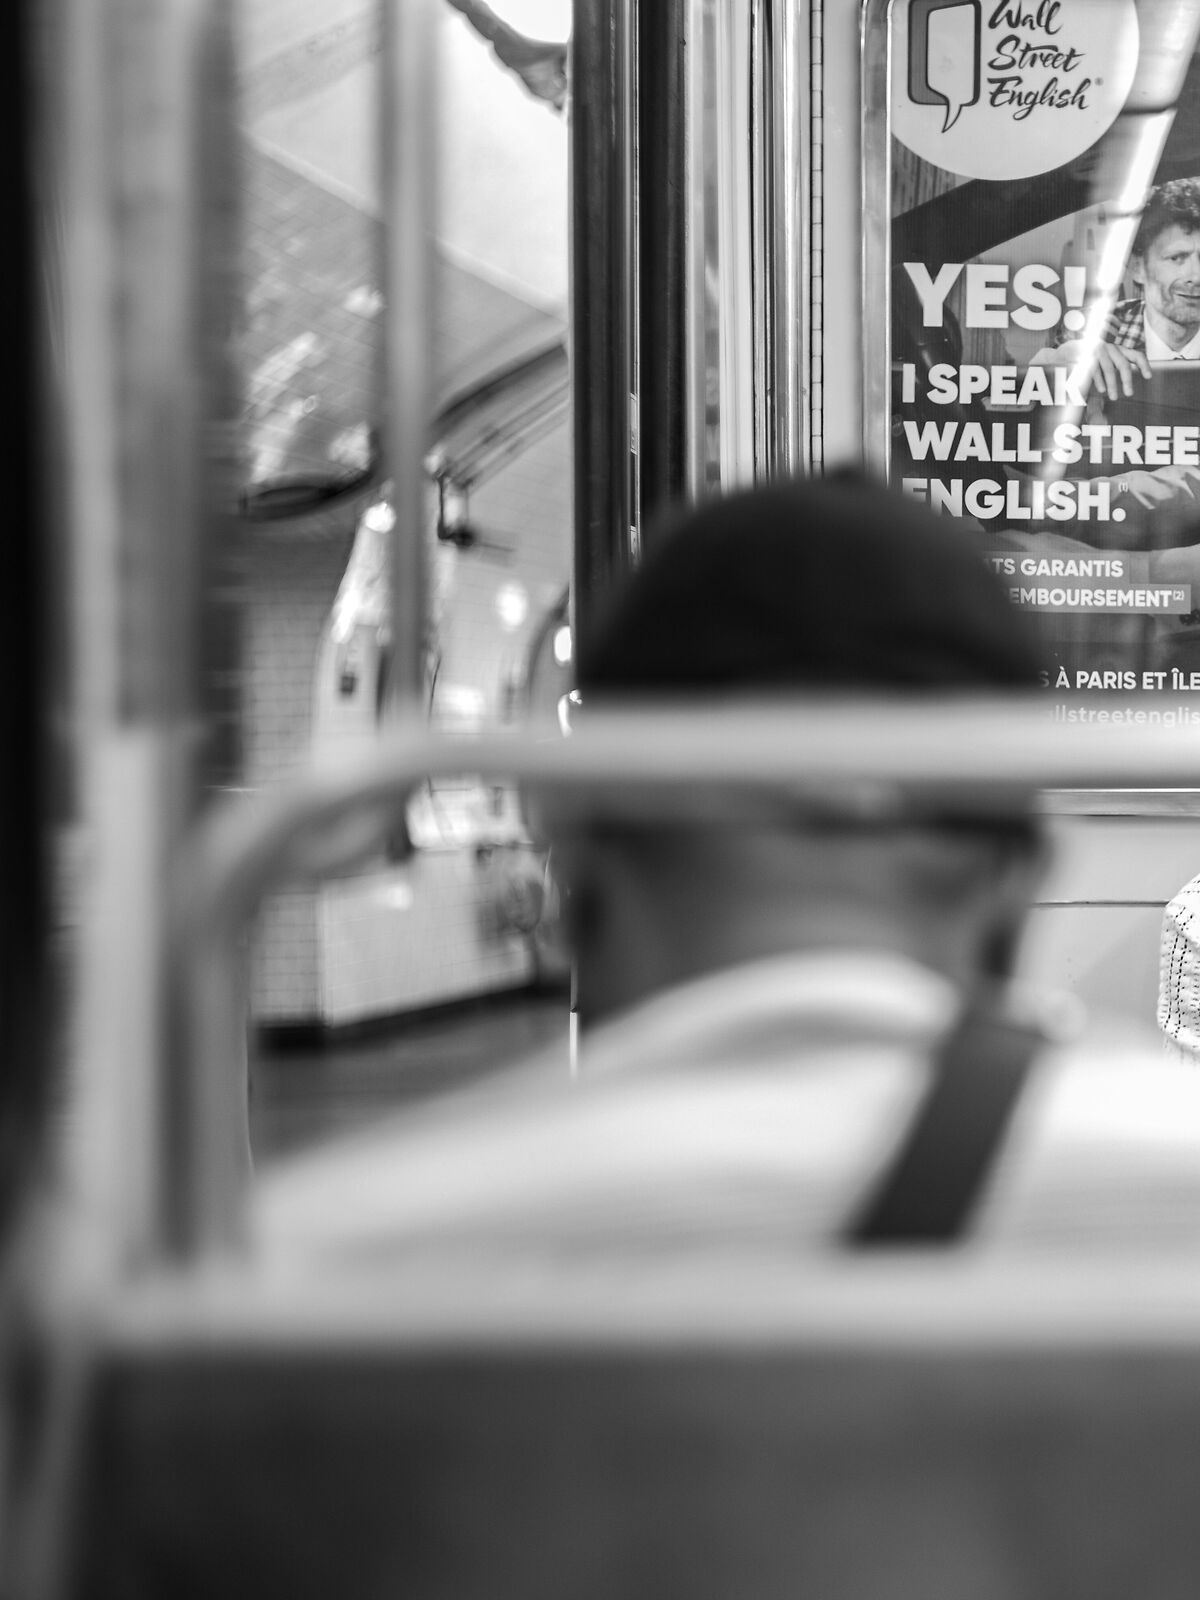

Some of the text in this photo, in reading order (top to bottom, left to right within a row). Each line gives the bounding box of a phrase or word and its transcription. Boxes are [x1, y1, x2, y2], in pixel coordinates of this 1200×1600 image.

[988, 0, 1064, 35] Wall
[987, 34, 1086, 72] Street
[987, 75, 1091, 120] English
[903, 262, 1086, 331] YES!
[902, 363, 1087, 406] I SPEAK
[902, 420, 1042, 462] WALL
[1020, 558, 1124, 577] GARANTIS
[1008, 587, 1185, 607] EMBOURSEMENT(2)
[1055, 665, 1070, 689] À
[1076, 671, 1136, 689] PARIS
[1142, 672, 1167, 690] ET
